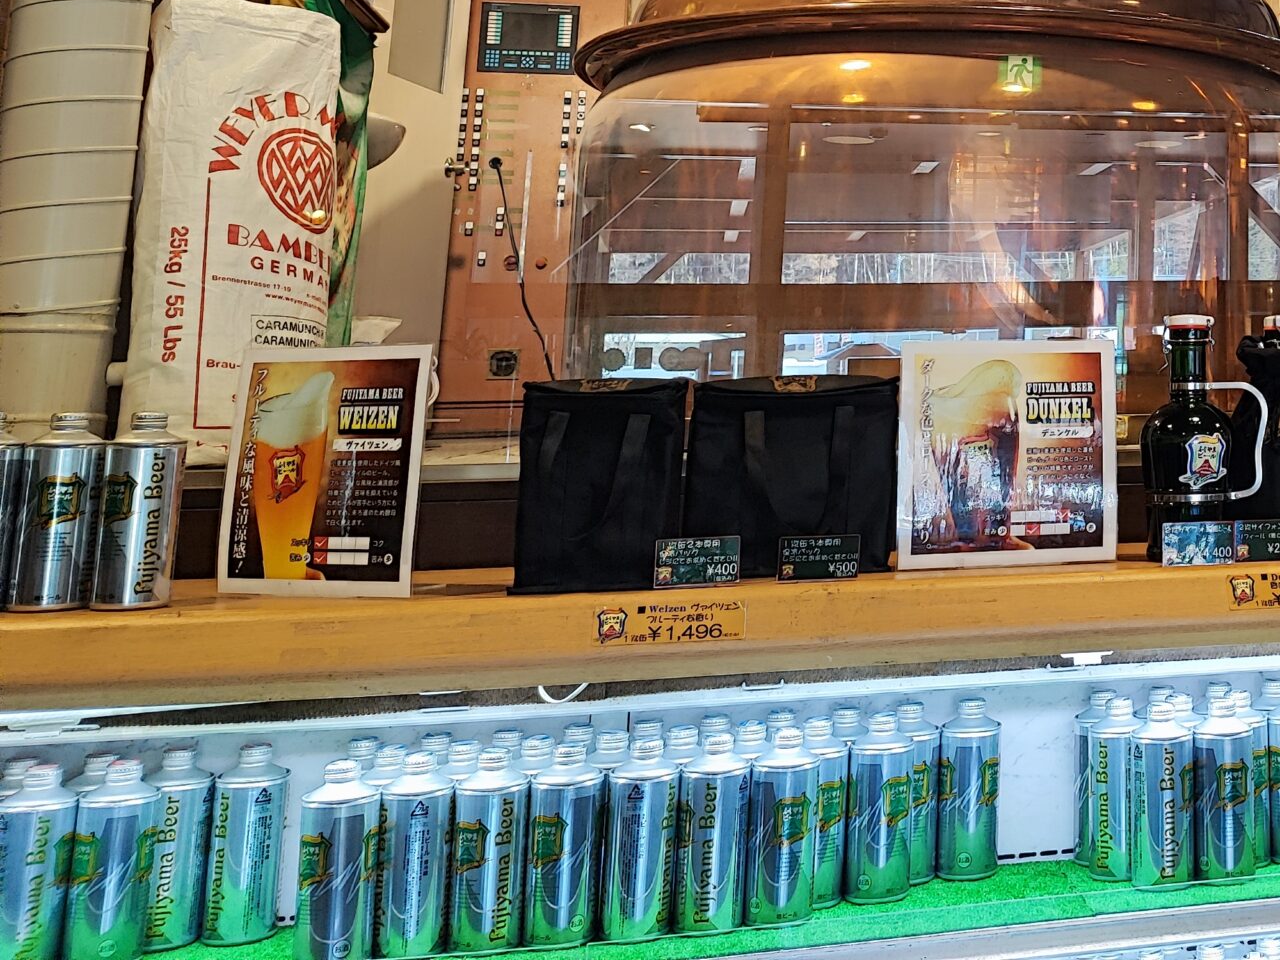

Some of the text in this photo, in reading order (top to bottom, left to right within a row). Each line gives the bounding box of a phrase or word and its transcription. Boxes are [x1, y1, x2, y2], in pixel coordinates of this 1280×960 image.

[164, 226, 190, 274] 25kg
[165, 294, 185, 319] 55
[161, 325, 184, 363] Lbs
[206, 359, 241, 370] Brau-
[341, 387, 404, 401] FUJIYAMA BEER
[1026, 381, 1094, 393] FUJIYAMA BEER
[338, 405, 399, 431] WEIZEN
[1027, 397, 1092, 420] DUNKEL
[345, 440, 389, 451] ヴァイツェン
[134, 453, 167, 596] Fujiyama Beer
[706, 563, 738, 576] ¥400
[828, 561, 858, 574] ¥500
[648, 604, 687, 613] Weizen
[156, 796, 180, 844] Beer
[214, 792, 231, 839] Beer
[1095, 740, 1113, 870] Fujiyama Beer
[1159, 747, 1180, 880] Fujiyama Beer
[25, 816, 51, 866] Beer
[692, 782, 718, 924] Fujiyama Beer
[489, 797, 514, 943] Fujiyama Beer
